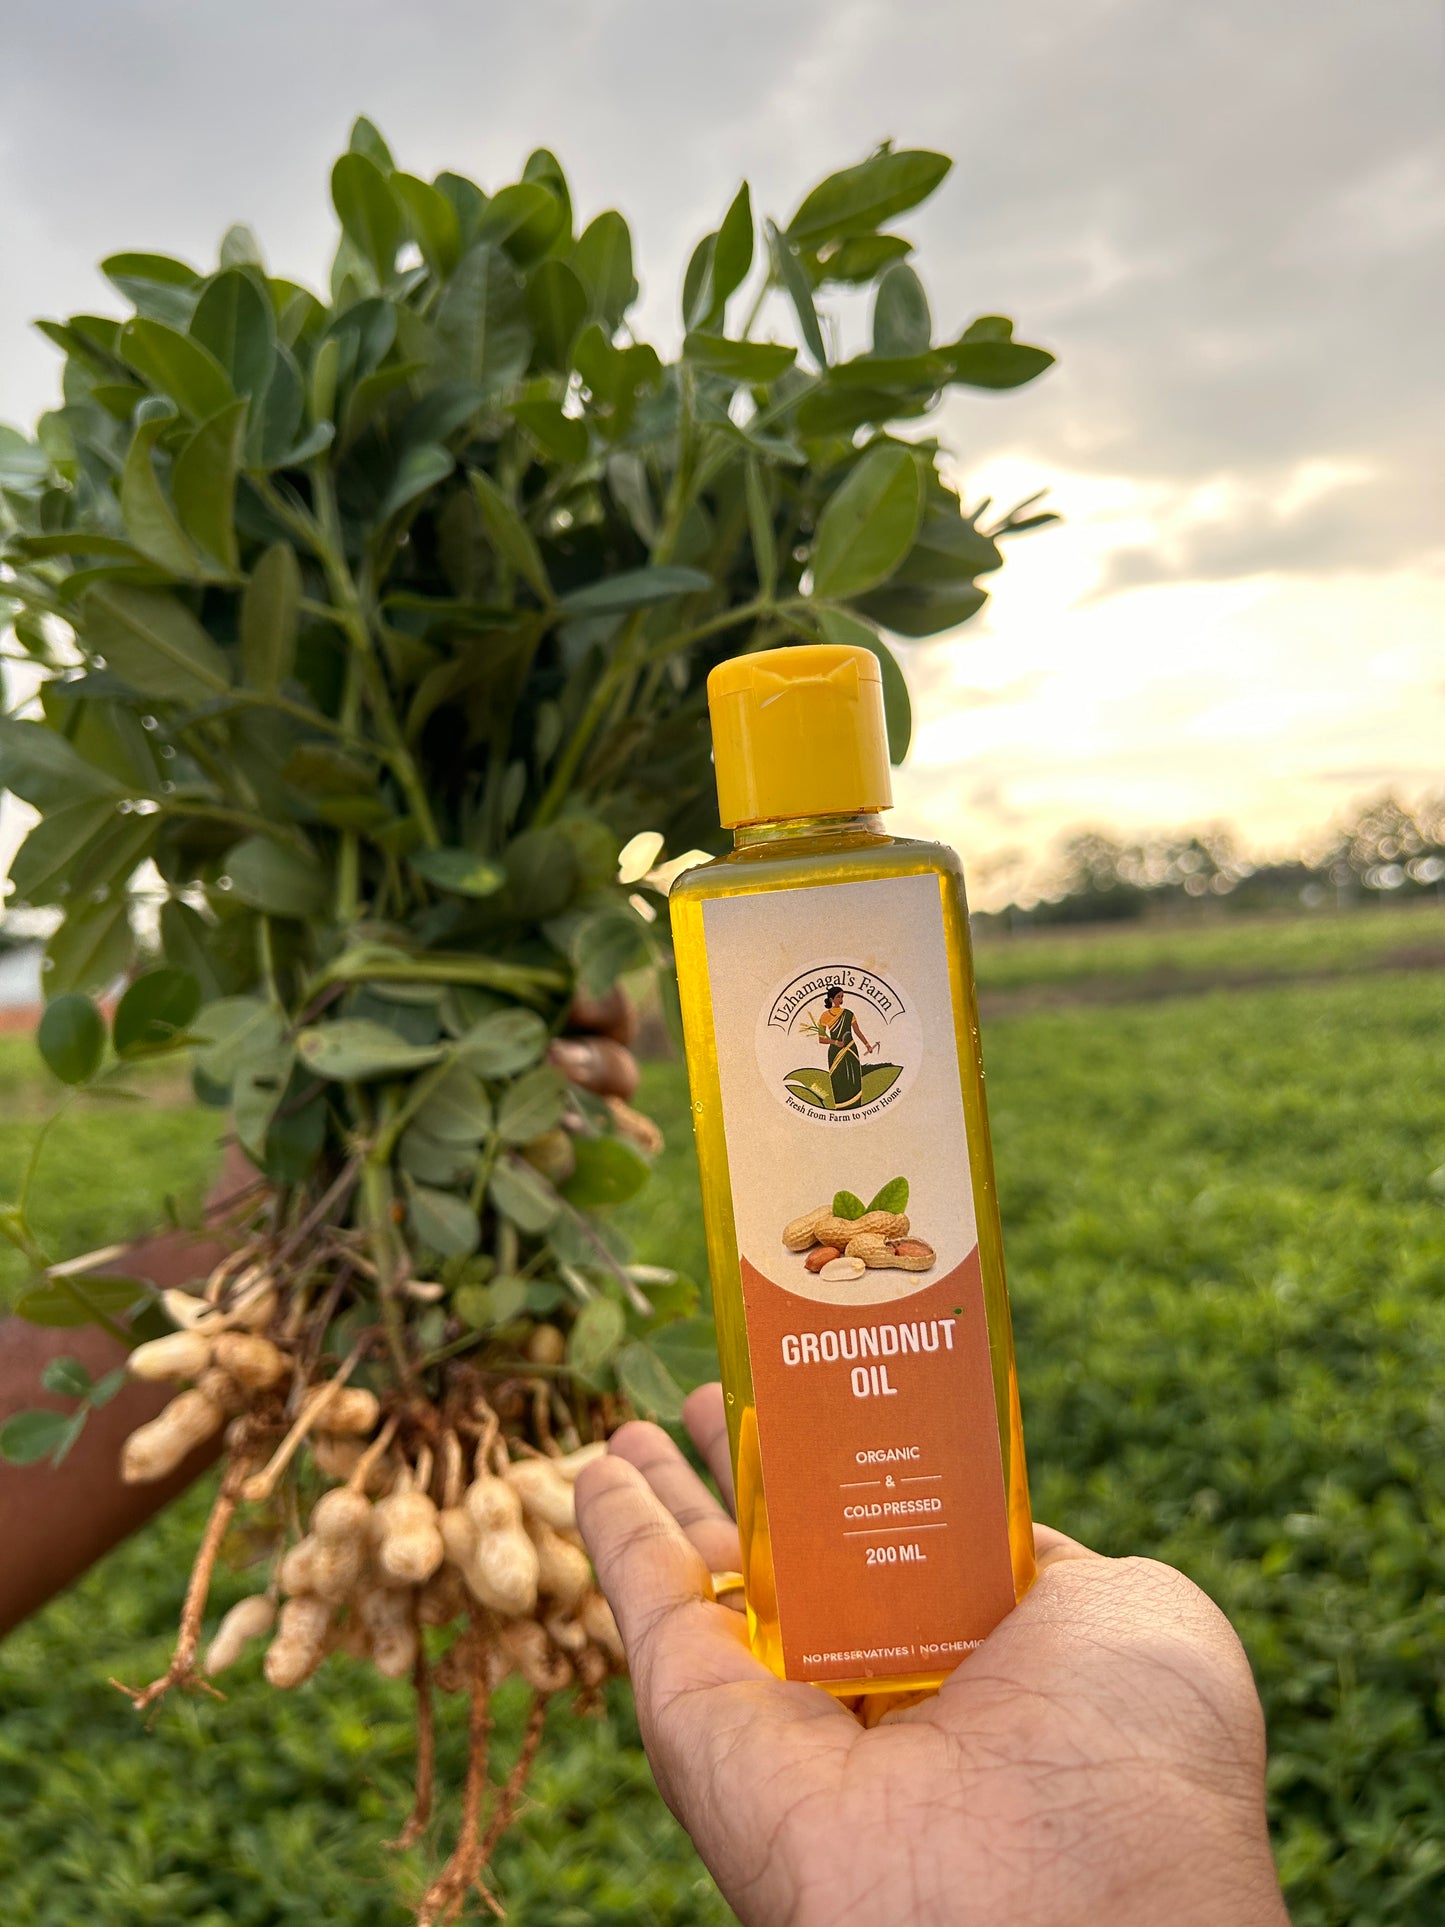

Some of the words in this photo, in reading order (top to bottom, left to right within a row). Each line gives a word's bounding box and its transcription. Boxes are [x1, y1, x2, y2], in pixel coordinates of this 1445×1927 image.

[773, 971, 855, 1023] Uzhamagal's
[858, 976, 892, 1012] Farm
[785, 1096, 806, 1114] Fresh
[807, 1109, 827, 1121] from
[829, 1113, 850, 1122] Farm
[852, 1112, 861, 1120] to
[862, 1105, 880, 1120] your
[881, 1087, 902, 1107] Home
[781, 1319, 956, 1365] GROUNDNUT
[850, 1365, 898, 1398] OIL
[855, 1446, 920, 1464] ORGANIC
[885, 1475, 895, 1488] &
[843, 1503, 882, 1518] COLD
[883, 1498, 942, 1516] PRESSED
[865, 1546, 897, 1565] 200
[899, 1543, 927, 1561] ML
[803, 1654, 821, 1664] NO
[823, 1646, 909, 1662] PRESERVATIVES
[920, 1644, 939, 1653] NO
